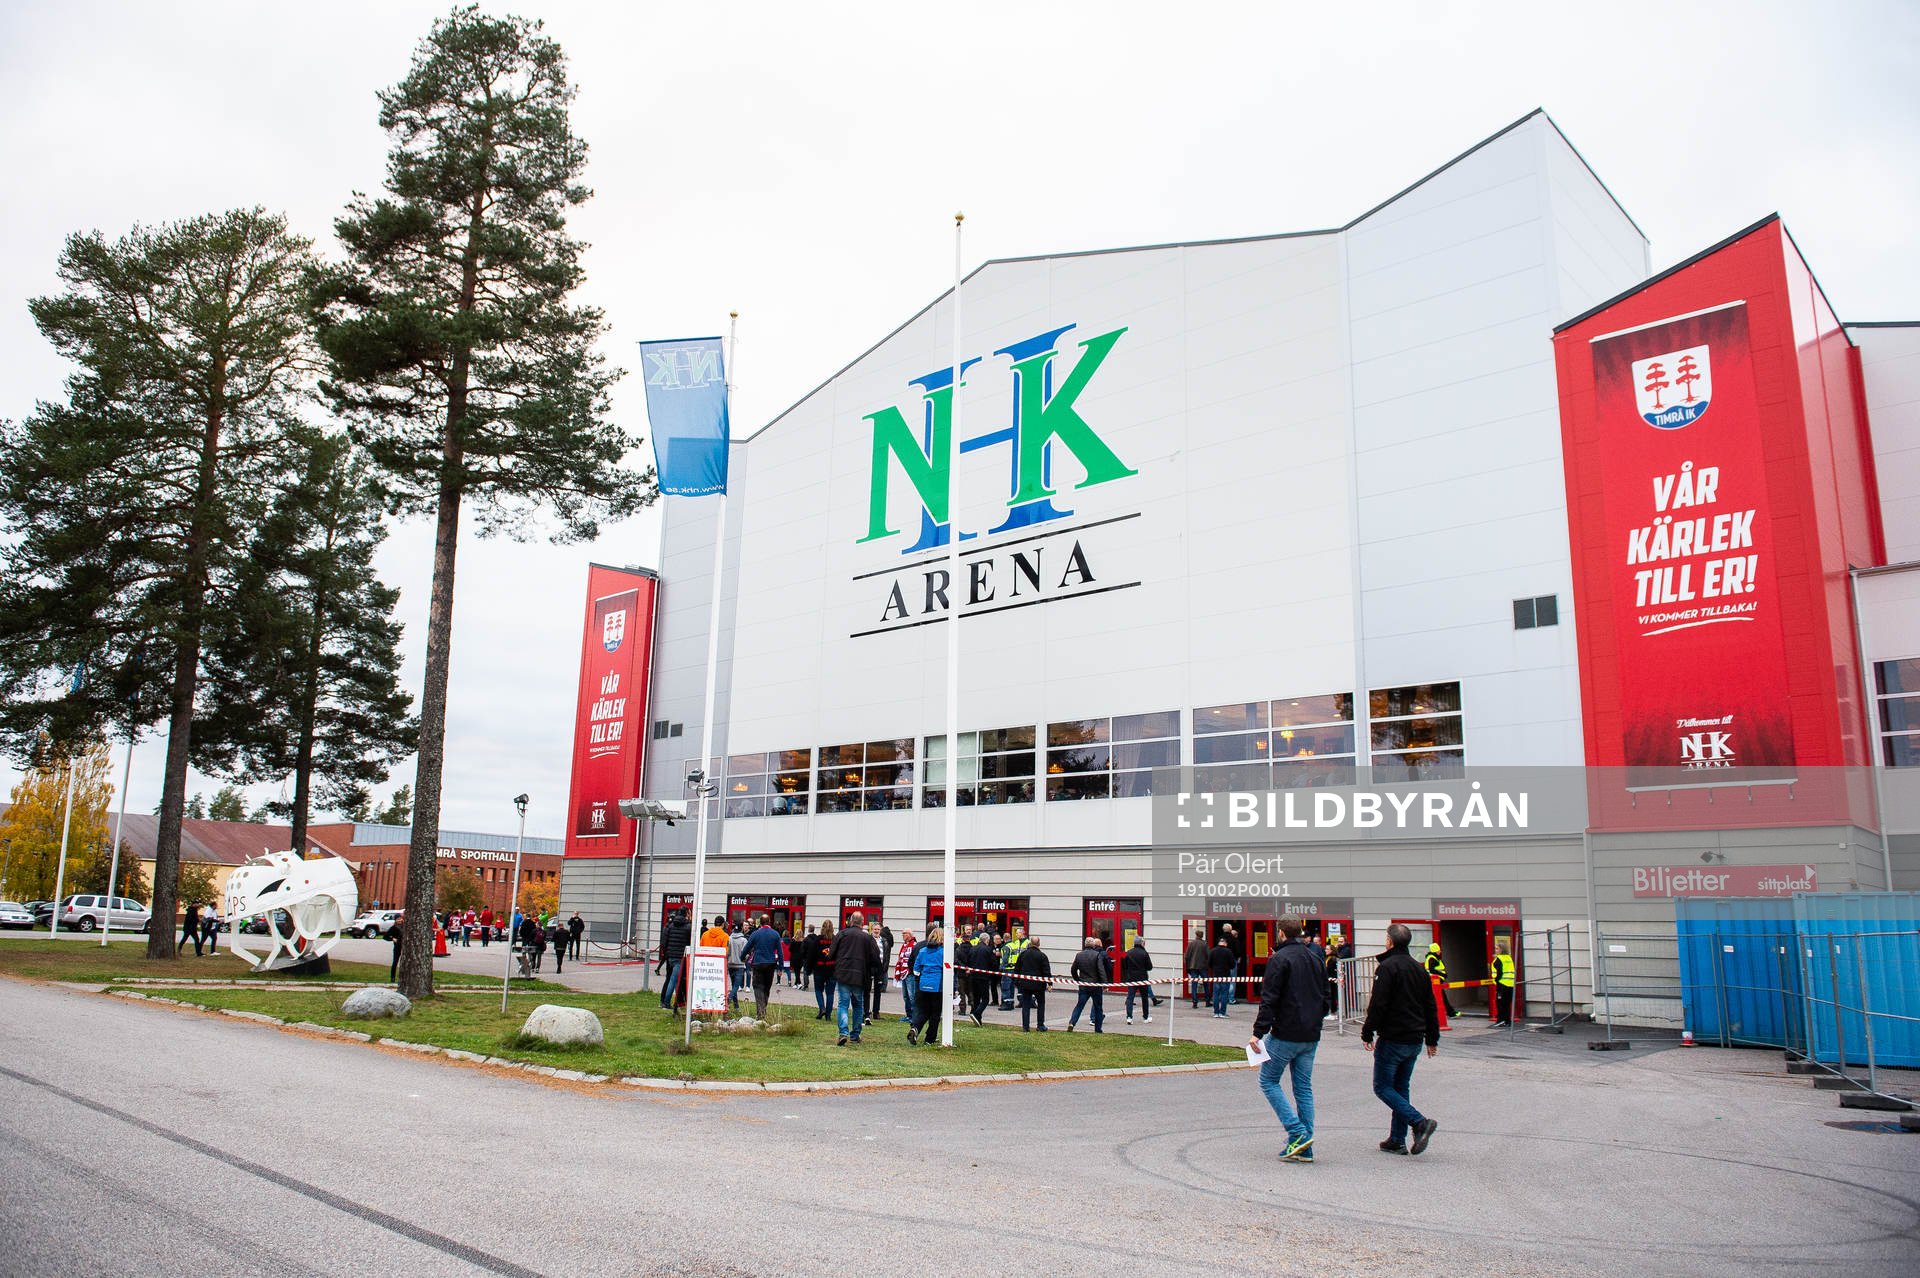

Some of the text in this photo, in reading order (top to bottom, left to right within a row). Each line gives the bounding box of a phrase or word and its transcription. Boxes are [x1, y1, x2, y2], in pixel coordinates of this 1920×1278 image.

[1655, 407, 1697, 426] TIMRÅ IK
[856, 322, 1139, 555] NHK
[1653, 460, 1719, 512] VÅR
[1627, 509, 1756, 565] KÄRLEK
[880, 539, 1097, 622] ARENA
[1634, 555, 1758, 607] TILL ER!
[1638, 601, 1758, 625] VI KOMMER TILLBAKA!
[601, 670, 620, 695] VÅR
[590, 698, 626, 722] KÄRLEK
[590, 721, 624, 744] TILL ER!
[1680, 731, 1735, 760] NHK
[1688, 761, 1730, 770] ARENA
[461, 850, 516, 862] SPORTHALL
[1634, 866, 1811, 897] Biljetter sittplats
[731, 896, 748, 905] Entré
[772, 897, 789, 906] Entré
[844, 898, 864, 907] Entré
[1088, 901, 1115, 911] Entré
[1212, 902, 1243, 913] Entré
[1285, 903, 1317, 914] Entré
[1439, 904, 1516, 915] Entré bortastå
